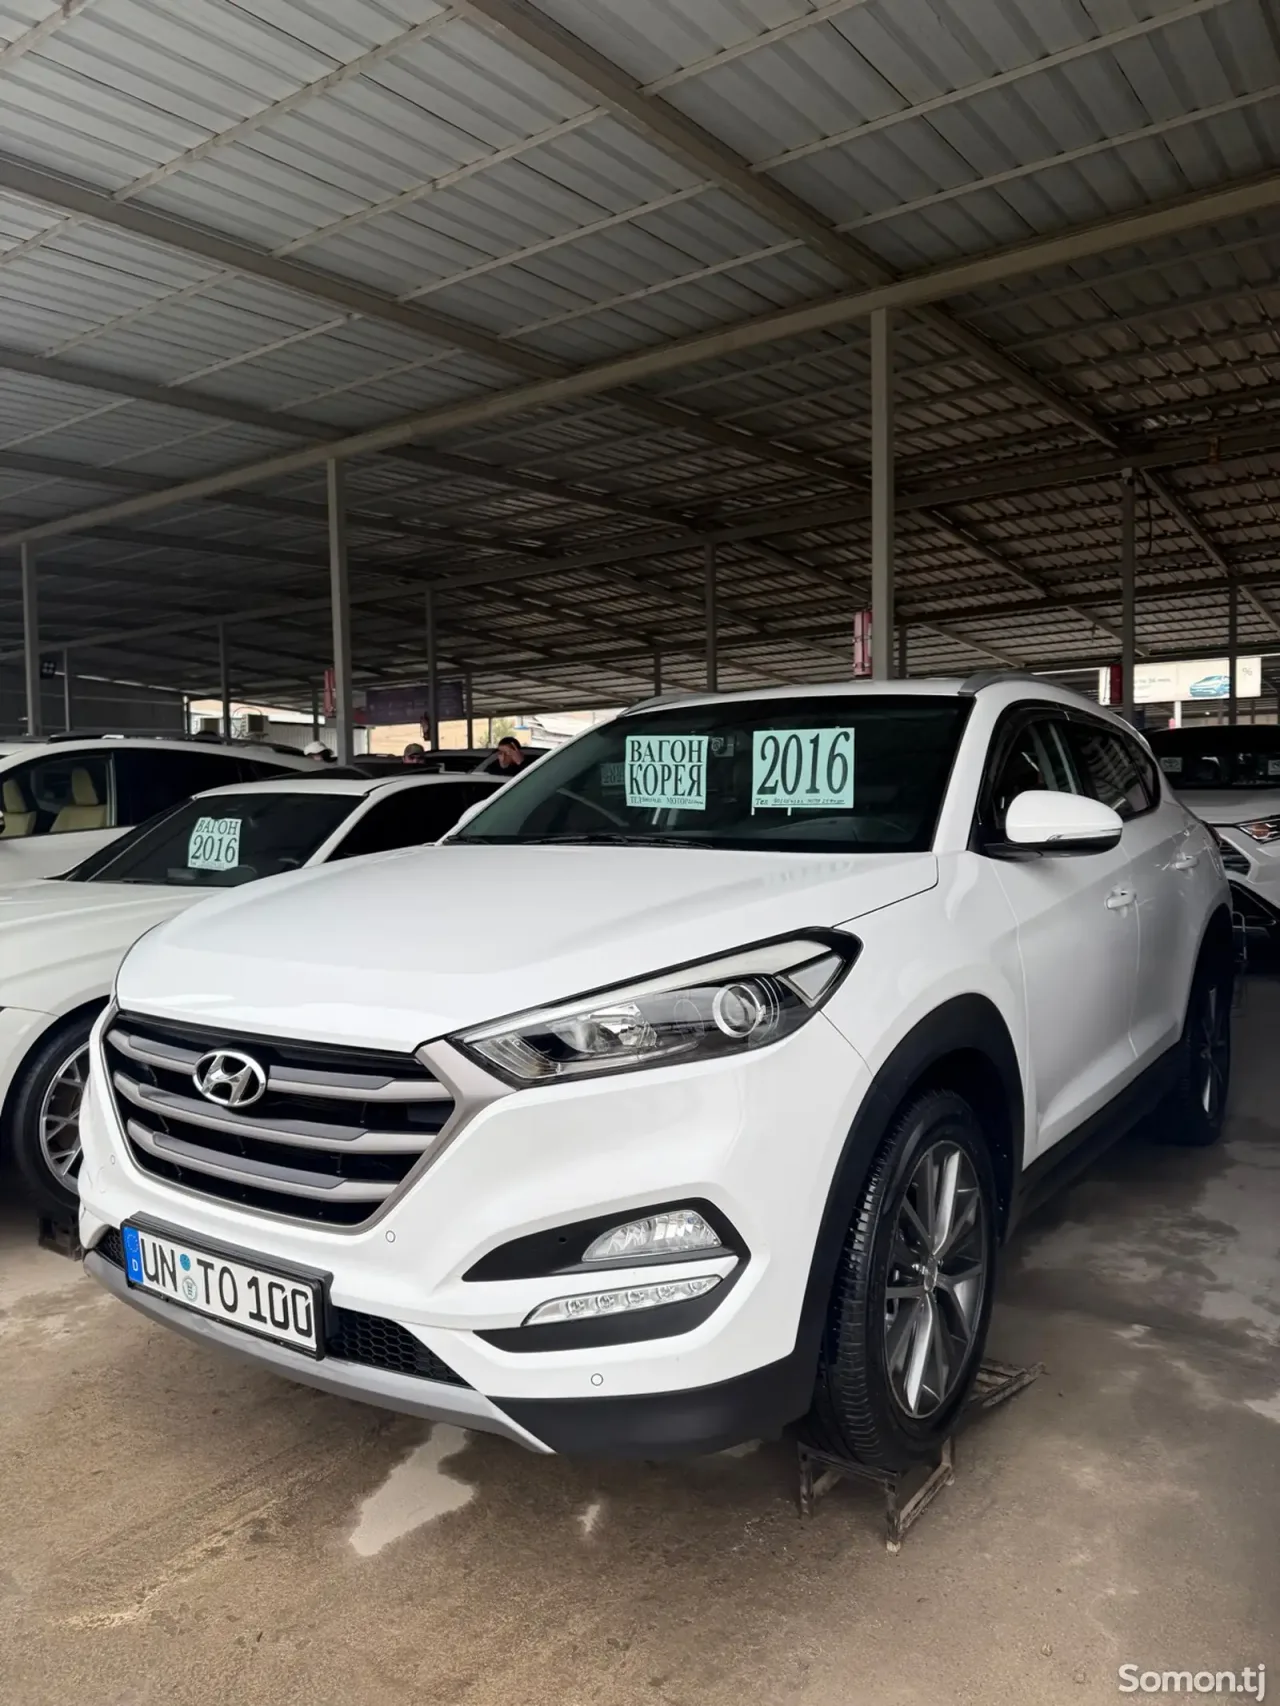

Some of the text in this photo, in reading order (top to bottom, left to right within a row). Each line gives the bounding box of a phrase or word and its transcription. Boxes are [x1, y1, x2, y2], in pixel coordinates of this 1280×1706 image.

[629, 739, 705, 763] ВАГОН
[756, 731, 850, 795] 2016
[628, 763, 704, 796] КОРЕЯ
[196, 819, 239, 835] ВАГОН
[191, 834, 237, 863] 2016
[132, 1258, 139, 1272] D
[140, 1237, 314, 1338] UN TO 100
